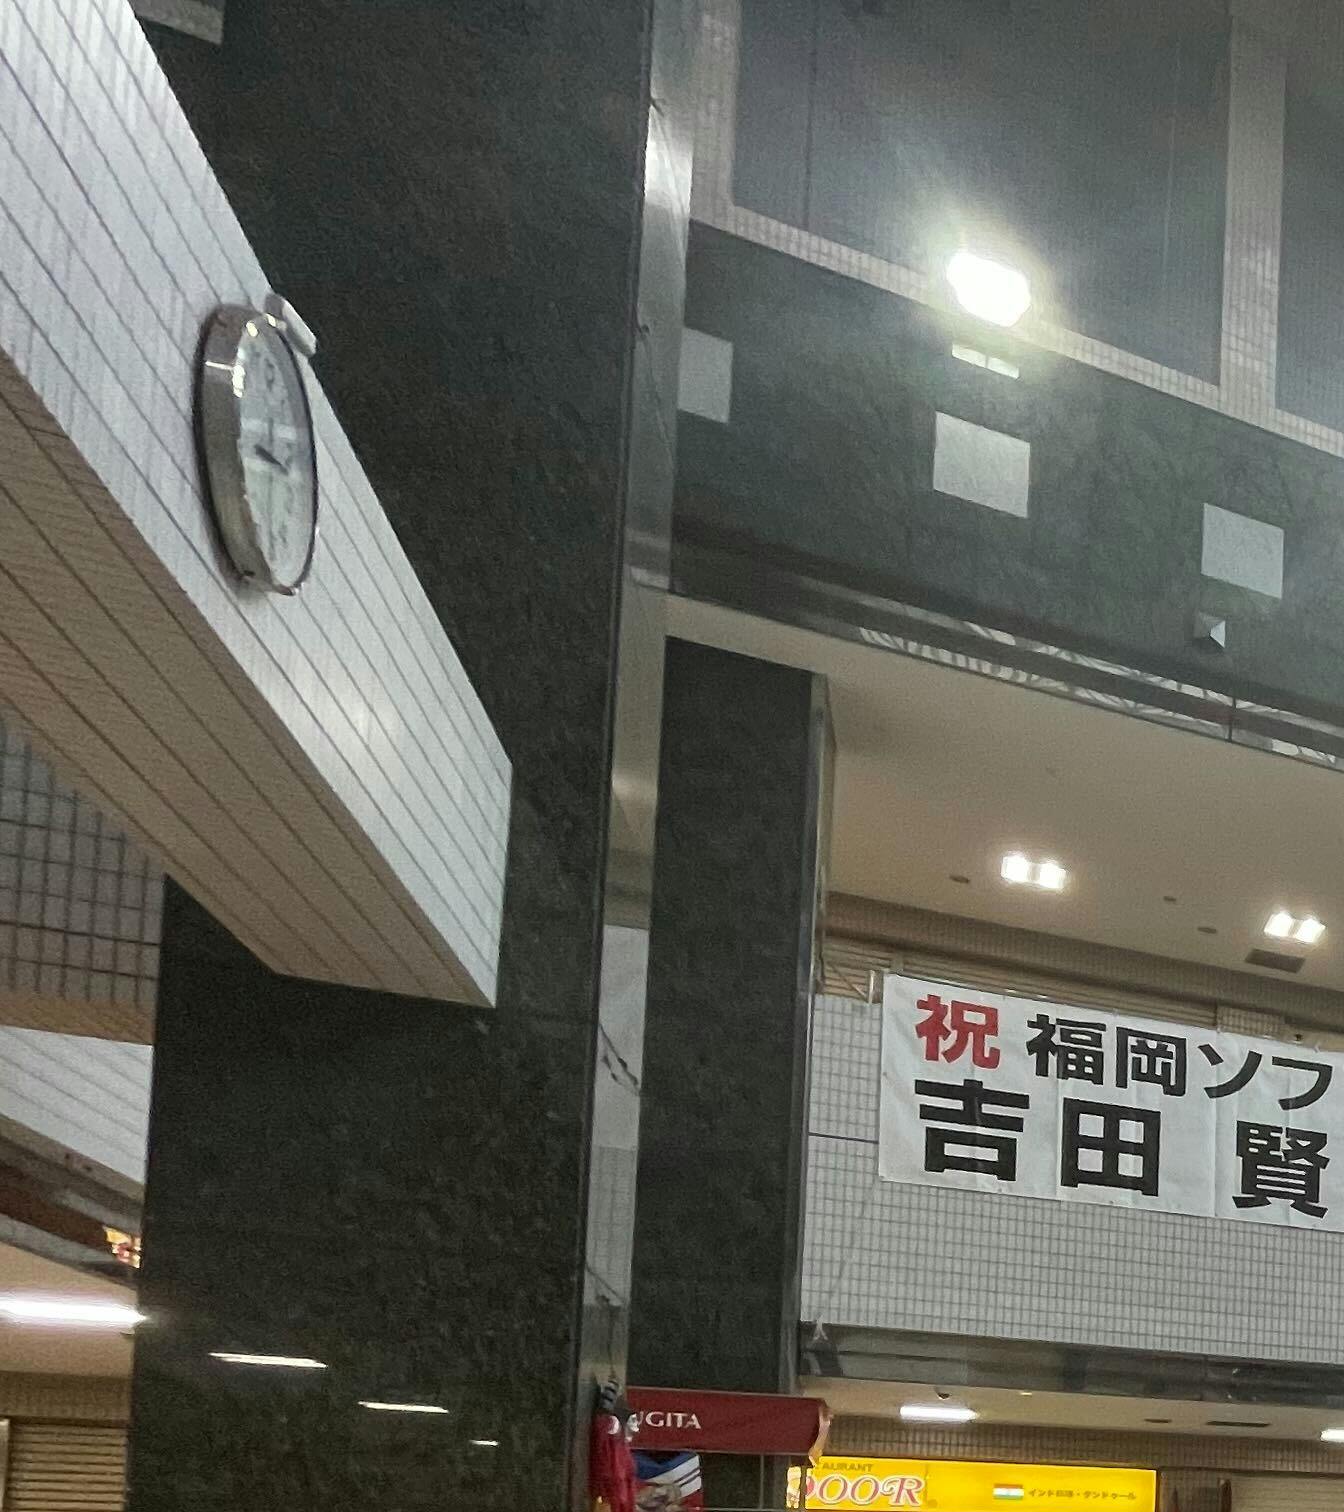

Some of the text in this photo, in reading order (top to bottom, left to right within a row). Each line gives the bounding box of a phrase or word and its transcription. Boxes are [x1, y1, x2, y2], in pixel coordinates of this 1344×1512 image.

[915, 994, 1001, 1069] 祝
[637, 1410, 702, 1431] GITA
[820, 1462, 874, 1473] AURANT
[806, 1473, 926, 1507] OOR
